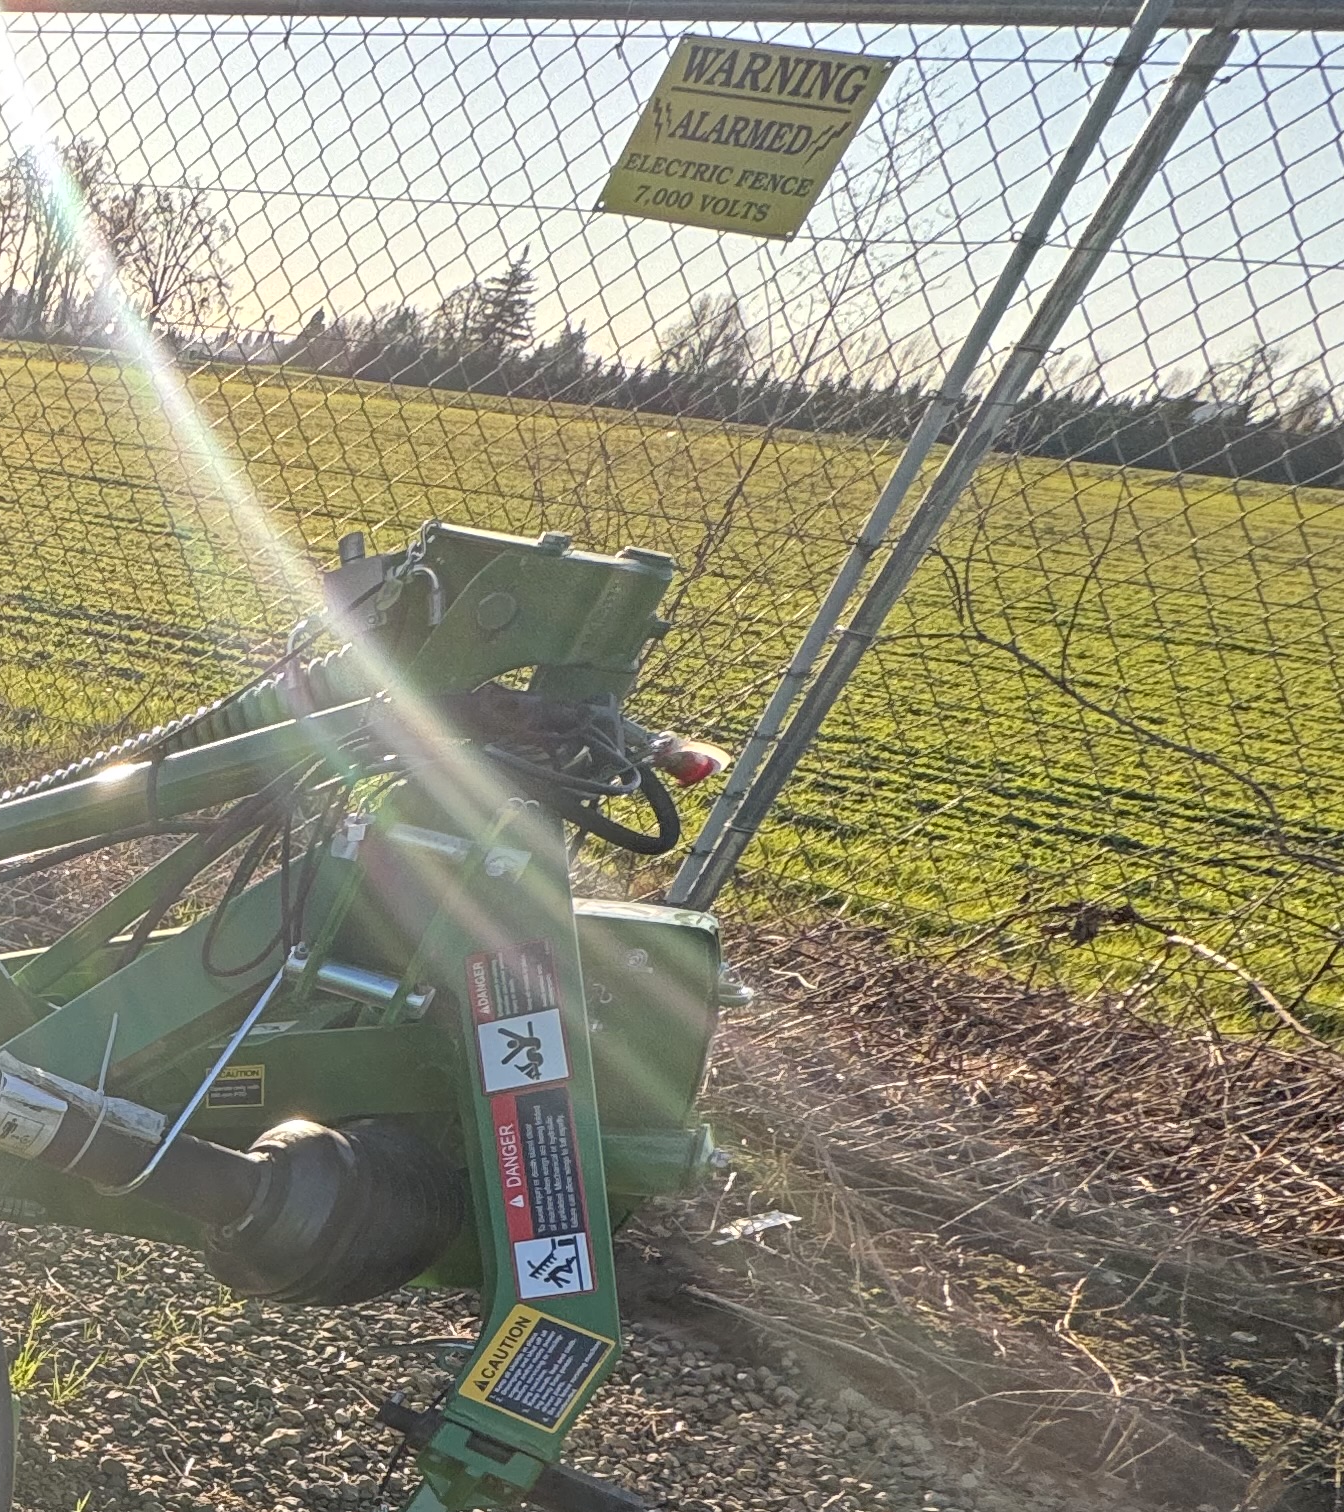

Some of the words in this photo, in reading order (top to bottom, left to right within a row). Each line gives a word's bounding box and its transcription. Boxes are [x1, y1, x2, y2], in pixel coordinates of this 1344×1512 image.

[682, 45, 871, 105] WARNING
[668, 109, 813, 156] ALARMED
[623, 153, 733, 186] ELECTRIC
[735, 170, 814, 198] FENCE
[632, 186, 693, 210] 7,000
[699, 195, 770, 222] VOLTS
[472, 961, 490, 1007] DANGER
[499, 1123, 519, 1187] DANGER
[481, 1315, 532, 1380] CAUTION
